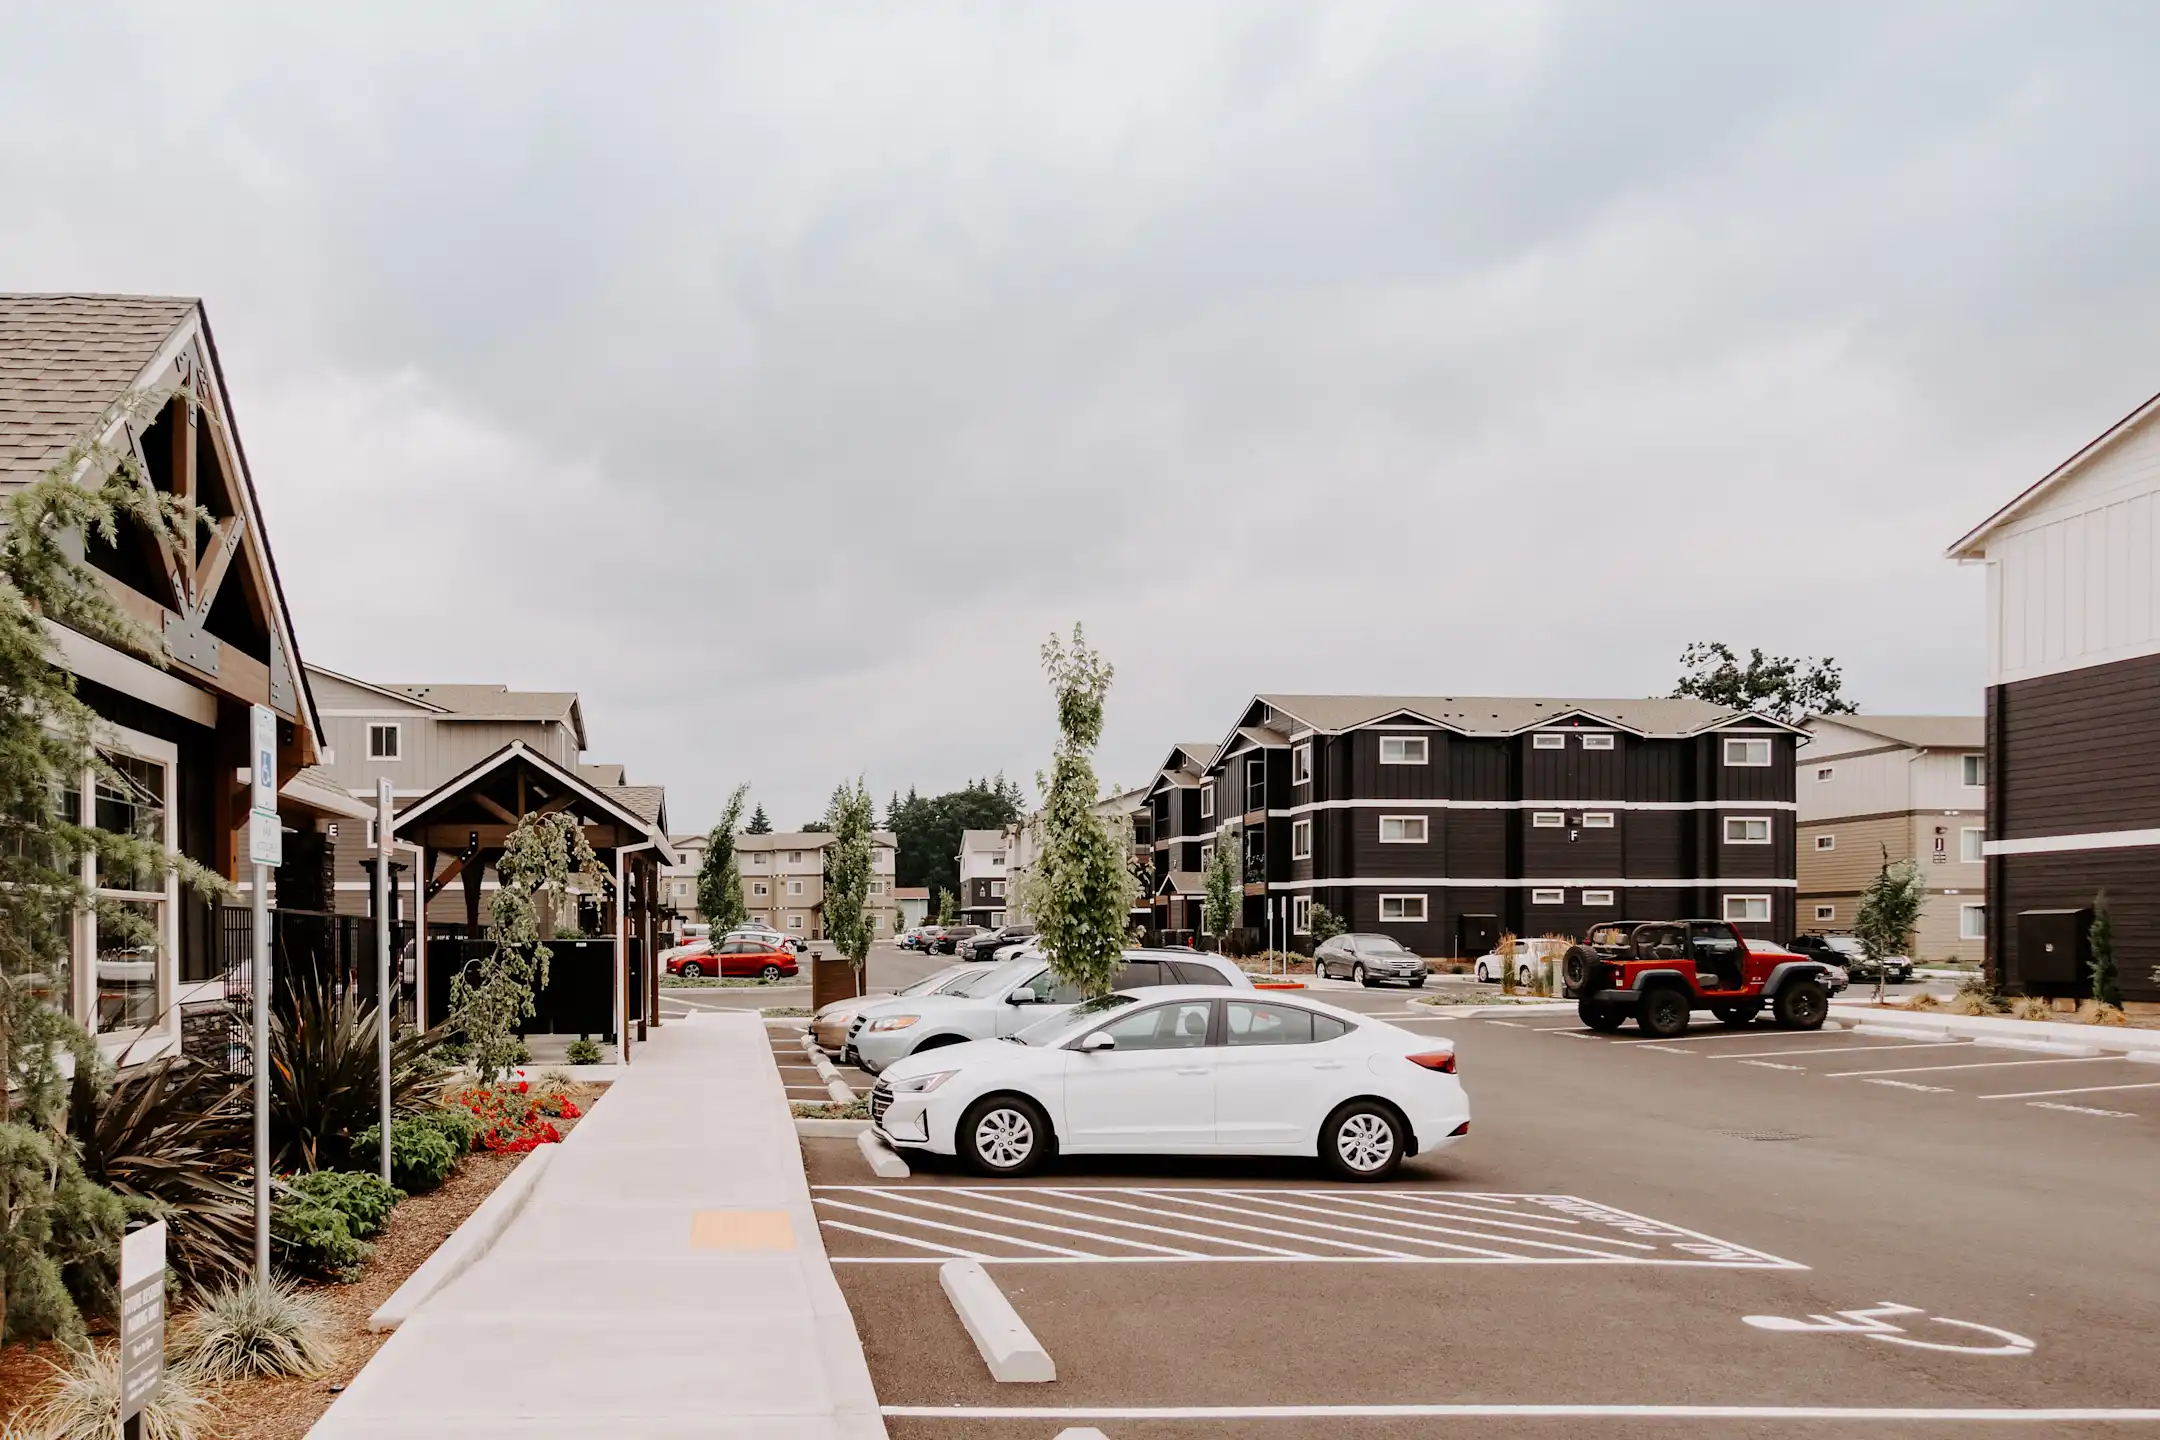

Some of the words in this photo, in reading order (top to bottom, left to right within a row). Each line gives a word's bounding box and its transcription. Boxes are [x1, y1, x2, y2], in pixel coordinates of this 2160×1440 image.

[329, 824, 338, 836] E
[1570, 830, 1578, 841] F
[1524, 1197, 1685, 1236] PARKING
[1671, 1242, 1765, 1261] NO
